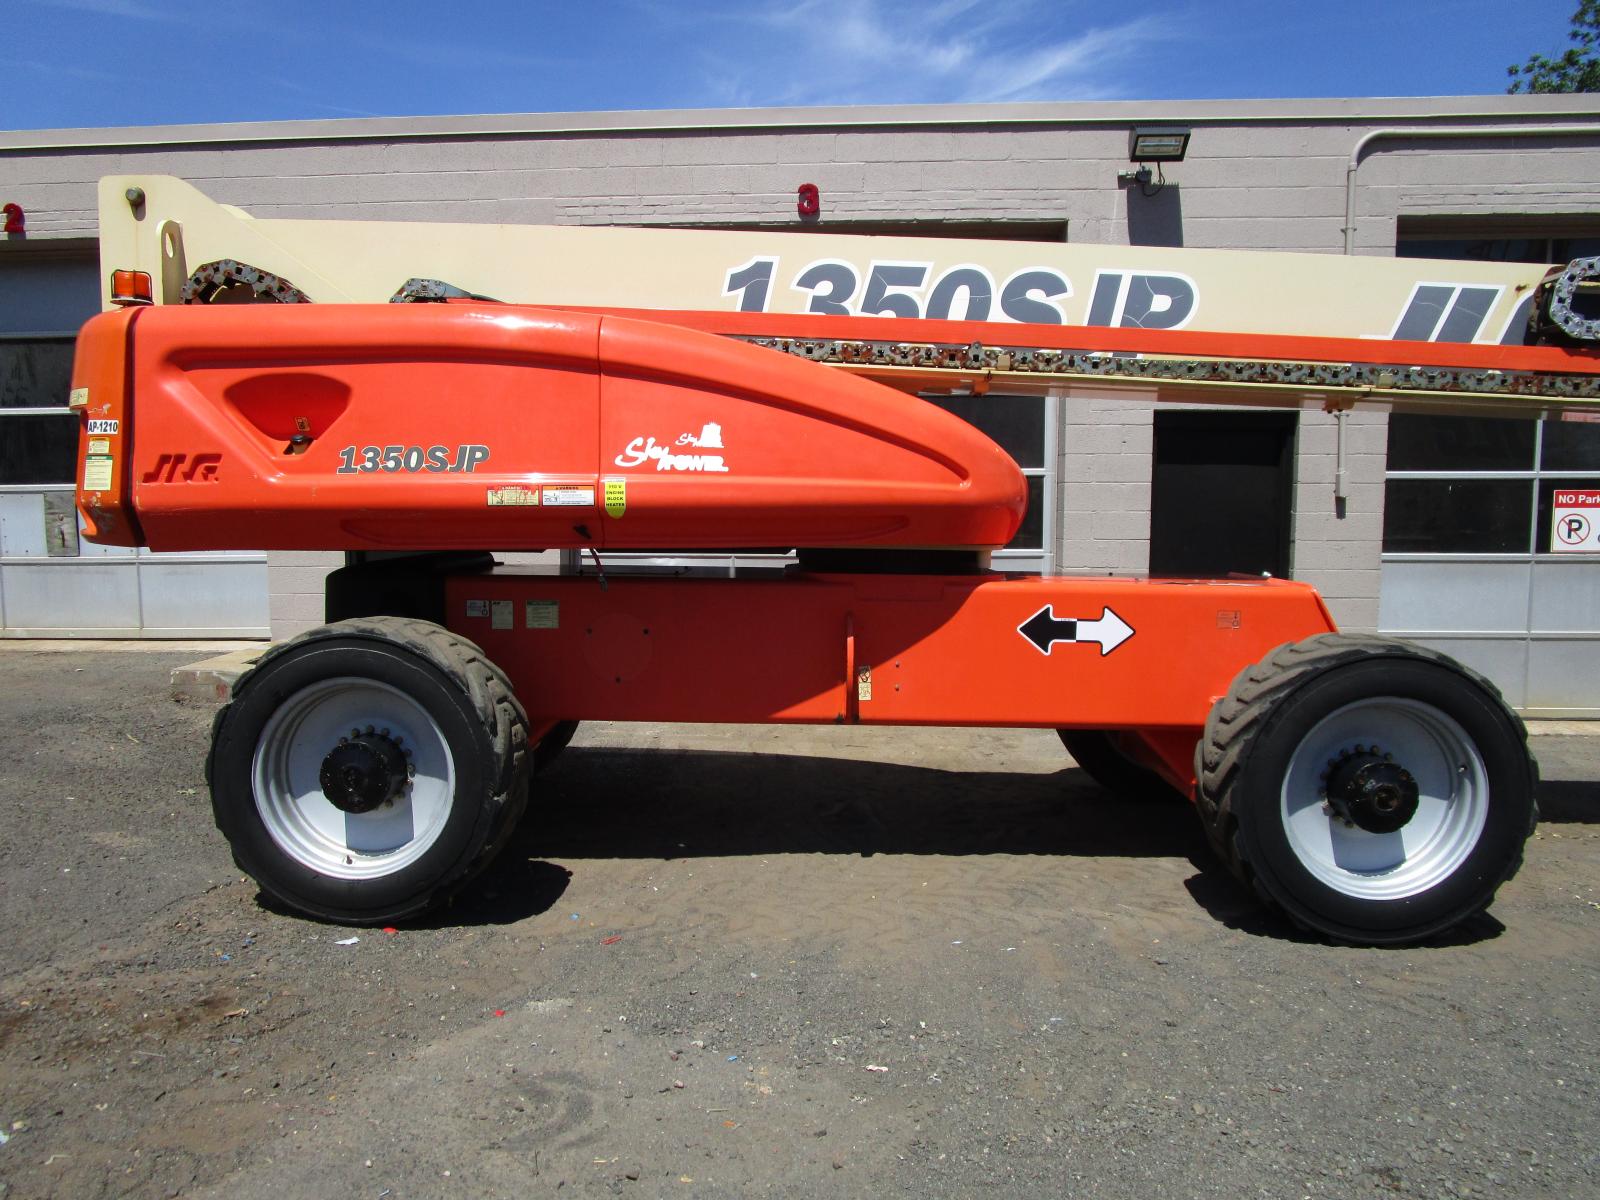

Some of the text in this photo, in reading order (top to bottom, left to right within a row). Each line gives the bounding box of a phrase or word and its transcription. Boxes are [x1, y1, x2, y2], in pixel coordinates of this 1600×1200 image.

[88, 421, 118, 433] AP-1210
[337, 444, 490, 474] 1350SJP
[1558, 494, 1576, 504] NO
